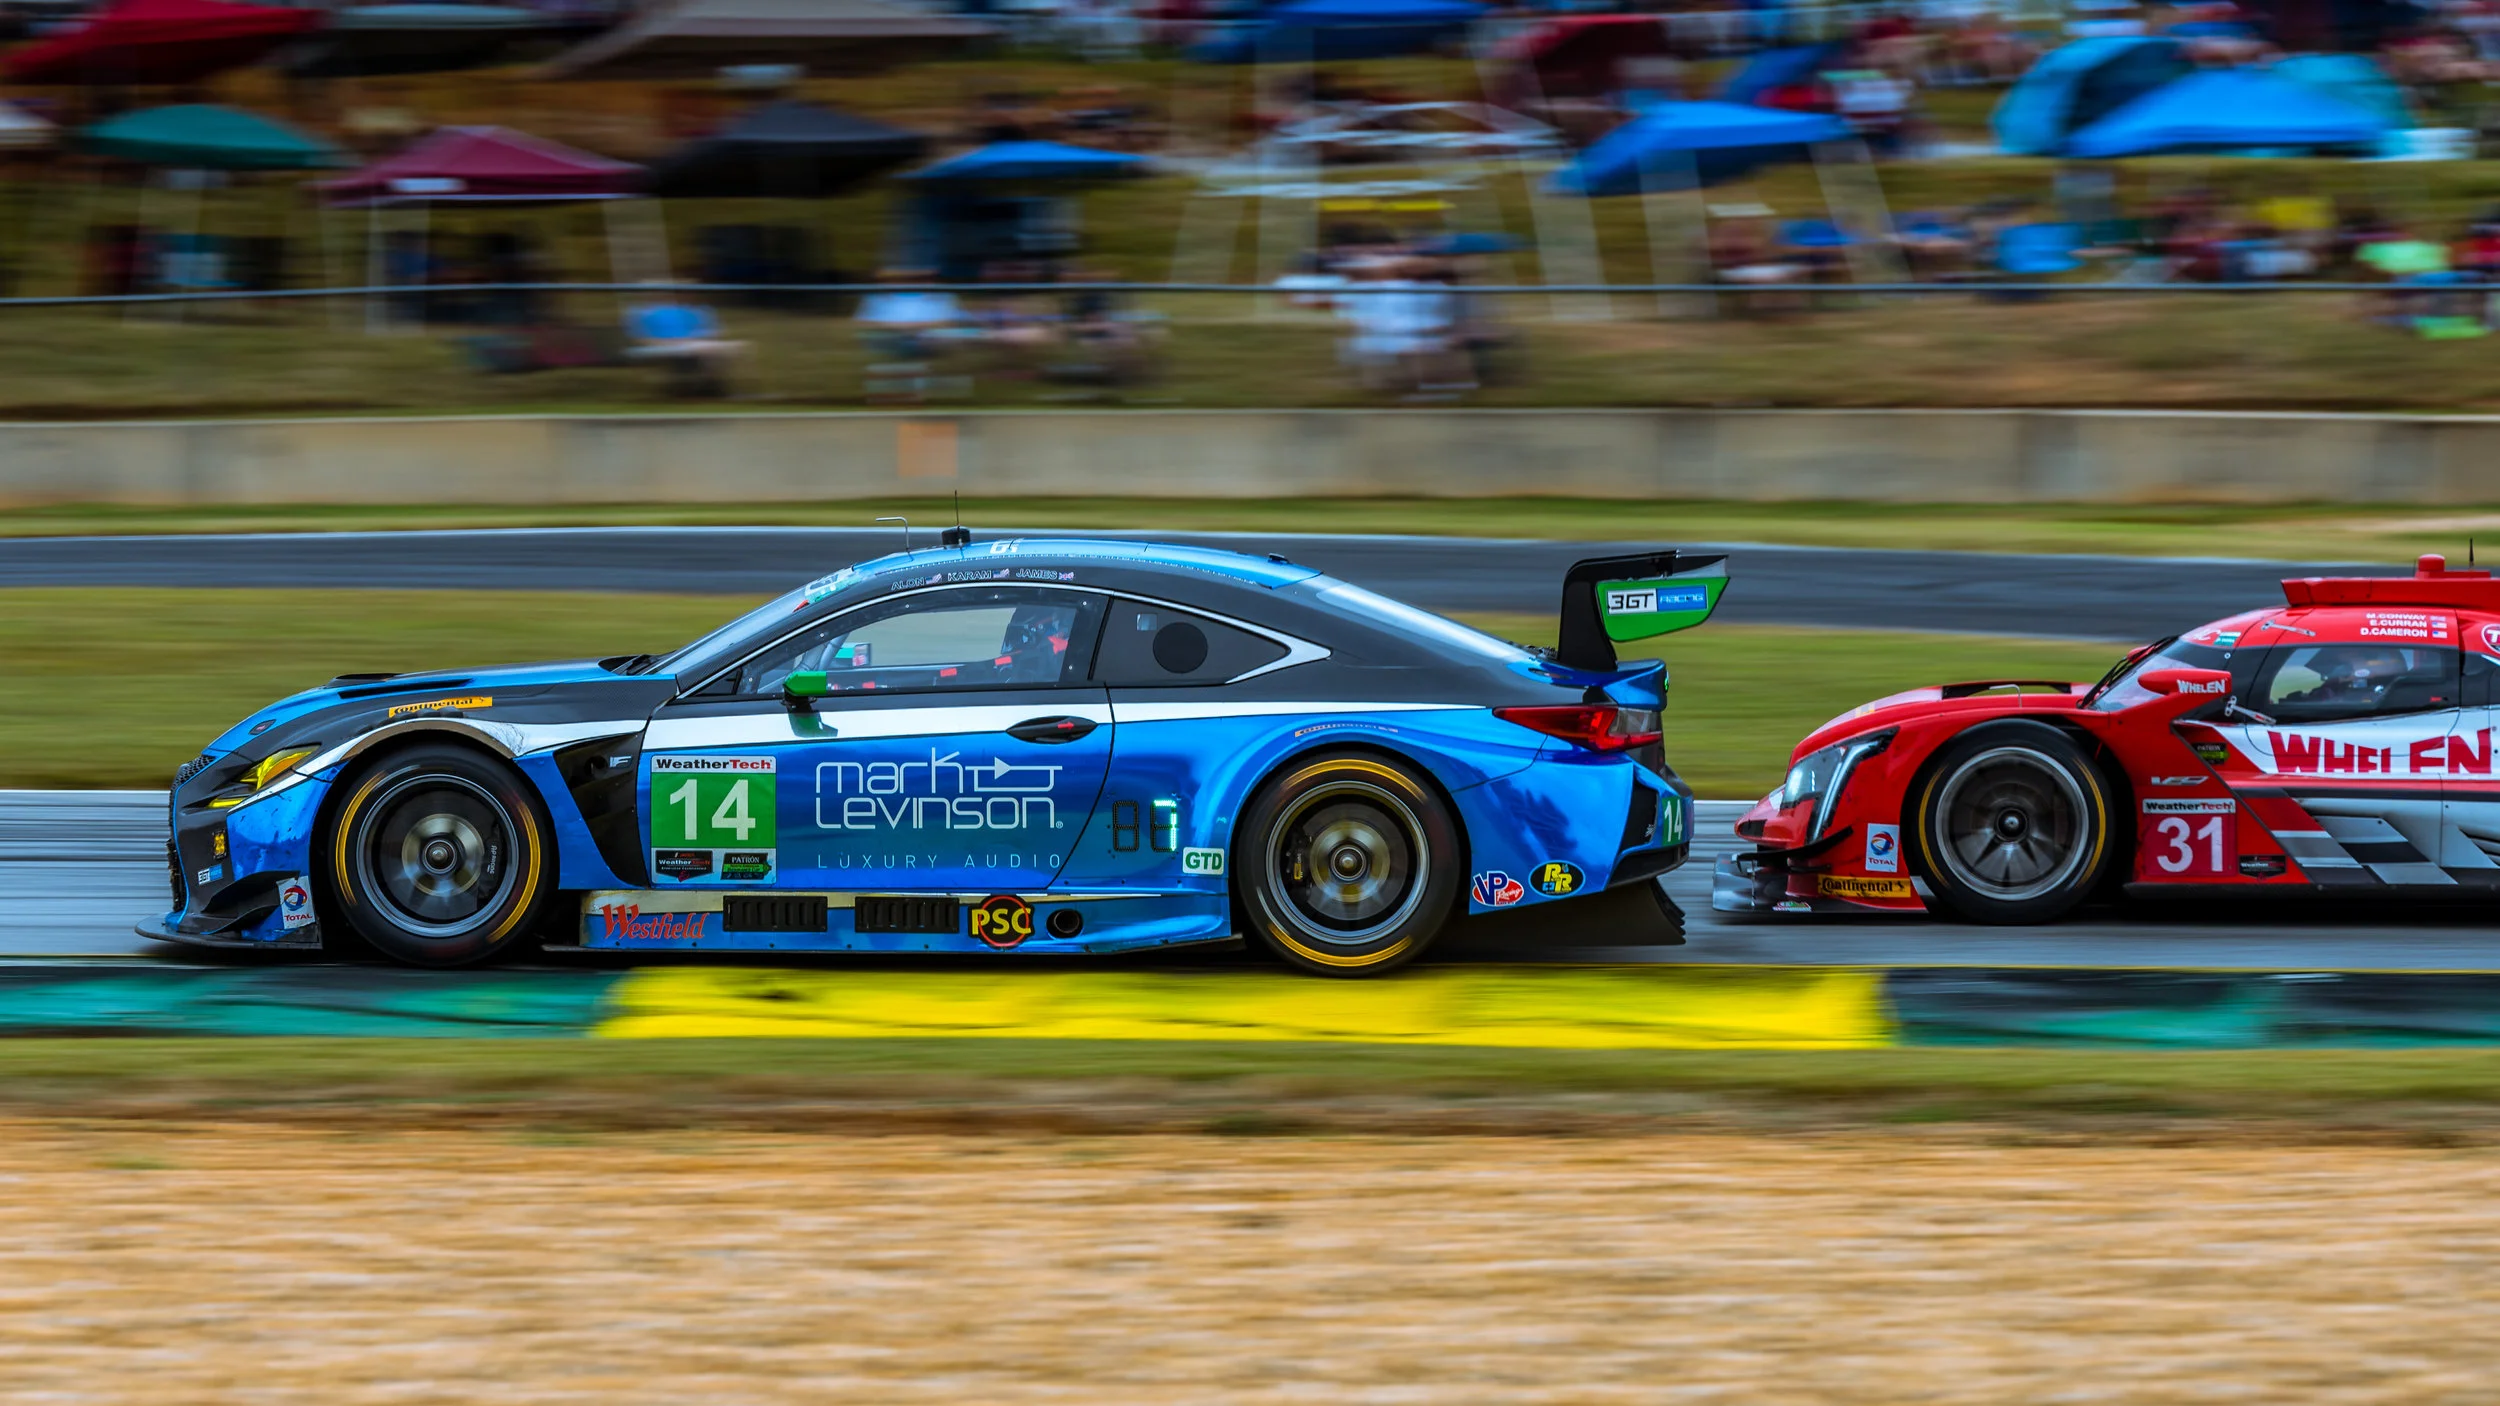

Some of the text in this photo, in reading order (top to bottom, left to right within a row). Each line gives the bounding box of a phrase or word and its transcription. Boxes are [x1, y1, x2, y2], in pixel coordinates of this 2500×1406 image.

[891, 568, 1058, 591] ALON KARAM JAMES
[1608, 593, 1654, 610] 3GT
[2366, 612, 2427, 620] M.CONWAY
[2369, 619, 2427, 628] E.CURRAN
[2360, 627, 2428, 638] D.CAMERON
[2176, 678, 2226, 694] WHELEN
[656, 758, 771, 770] WeatherTech
[669, 778, 756, 841] 14
[2145, 801, 2233, 812] WeatherTech
[1663, 798, 1683, 843] 14
[2157, 816, 2224, 873] 31
[817, 853, 1061, 869] LUXURY AUDIO
[1185, 851, 1223, 871] GTD
[1867, 857, 1896, 866] TOTAL
[1819, 877, 1894, 893] Continental
[284, 913, 313, 921] TOTAL
[599, 903, 710, 939] Westfield
[971, 907, 1032, 936] PSC
